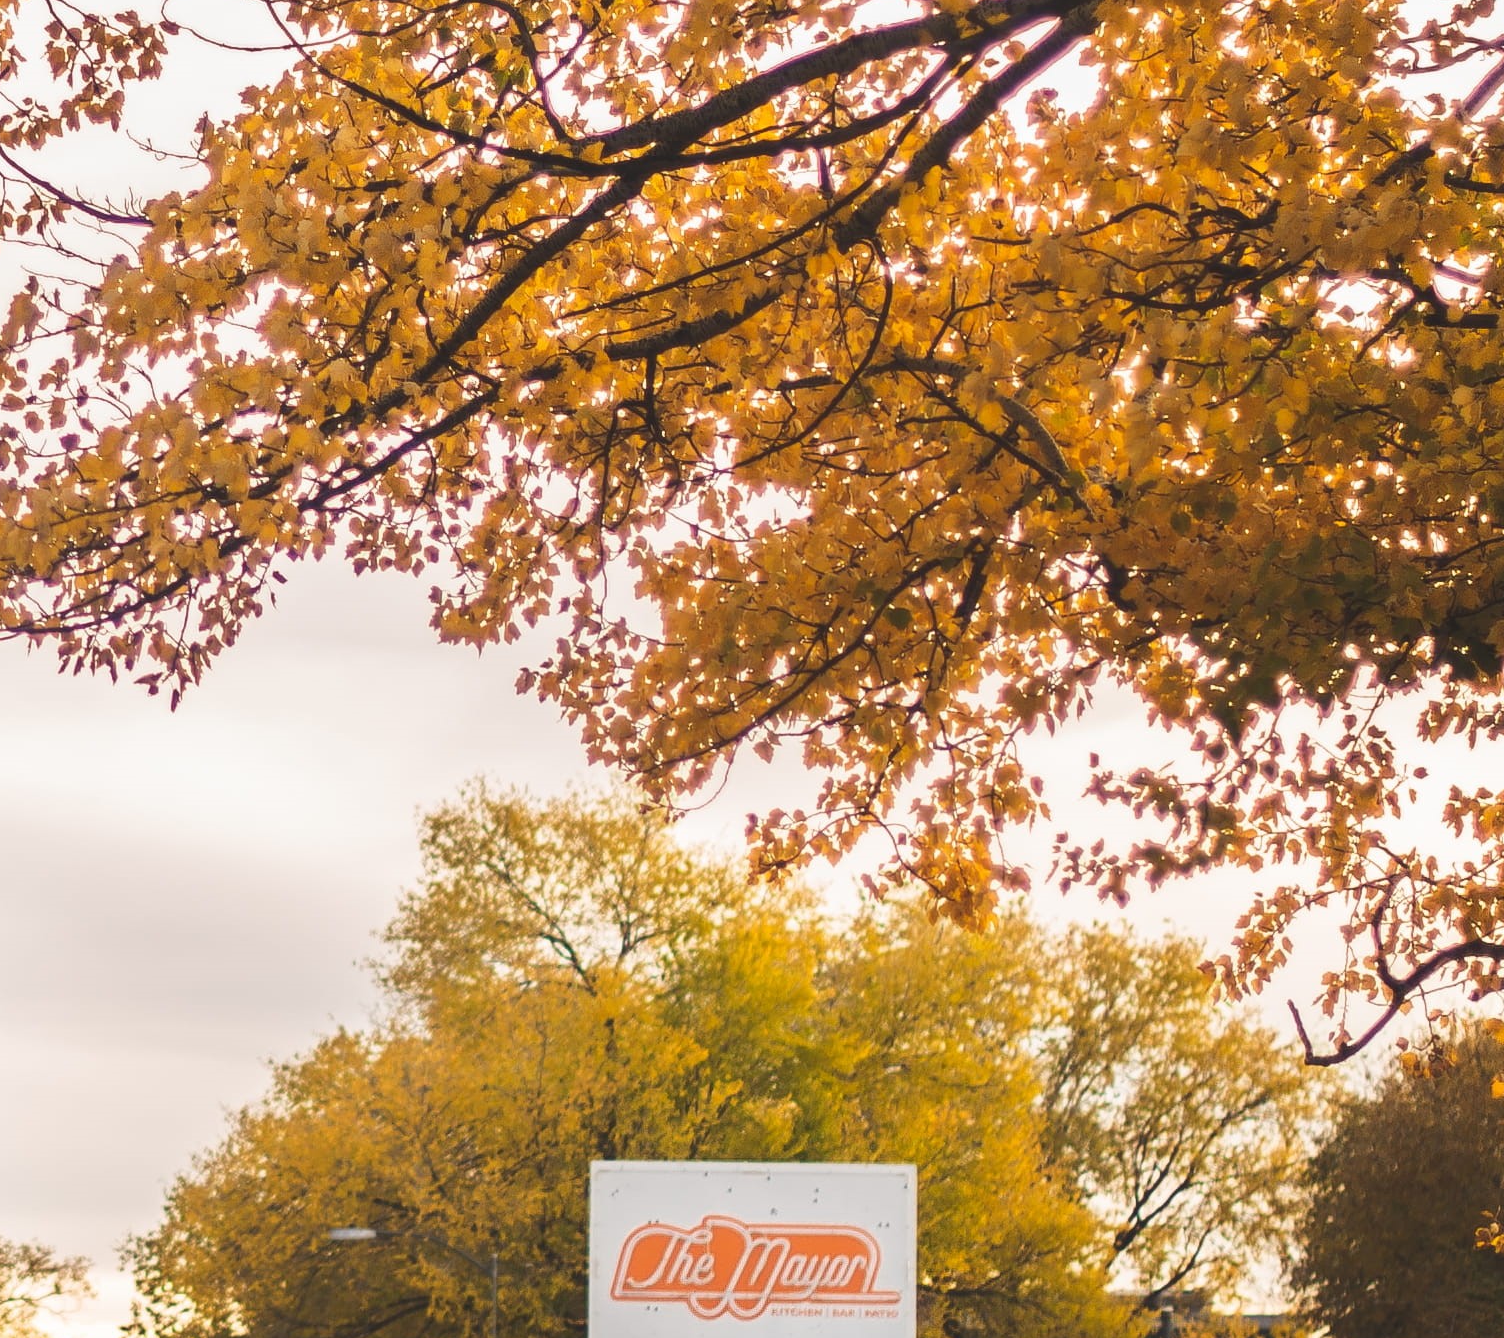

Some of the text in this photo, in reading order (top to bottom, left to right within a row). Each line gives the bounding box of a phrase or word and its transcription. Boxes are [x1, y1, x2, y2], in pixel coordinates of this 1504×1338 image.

[627, 1228, 868, 1314] The Mayor
[771, 1308, 823, 1317] KITCHEN
